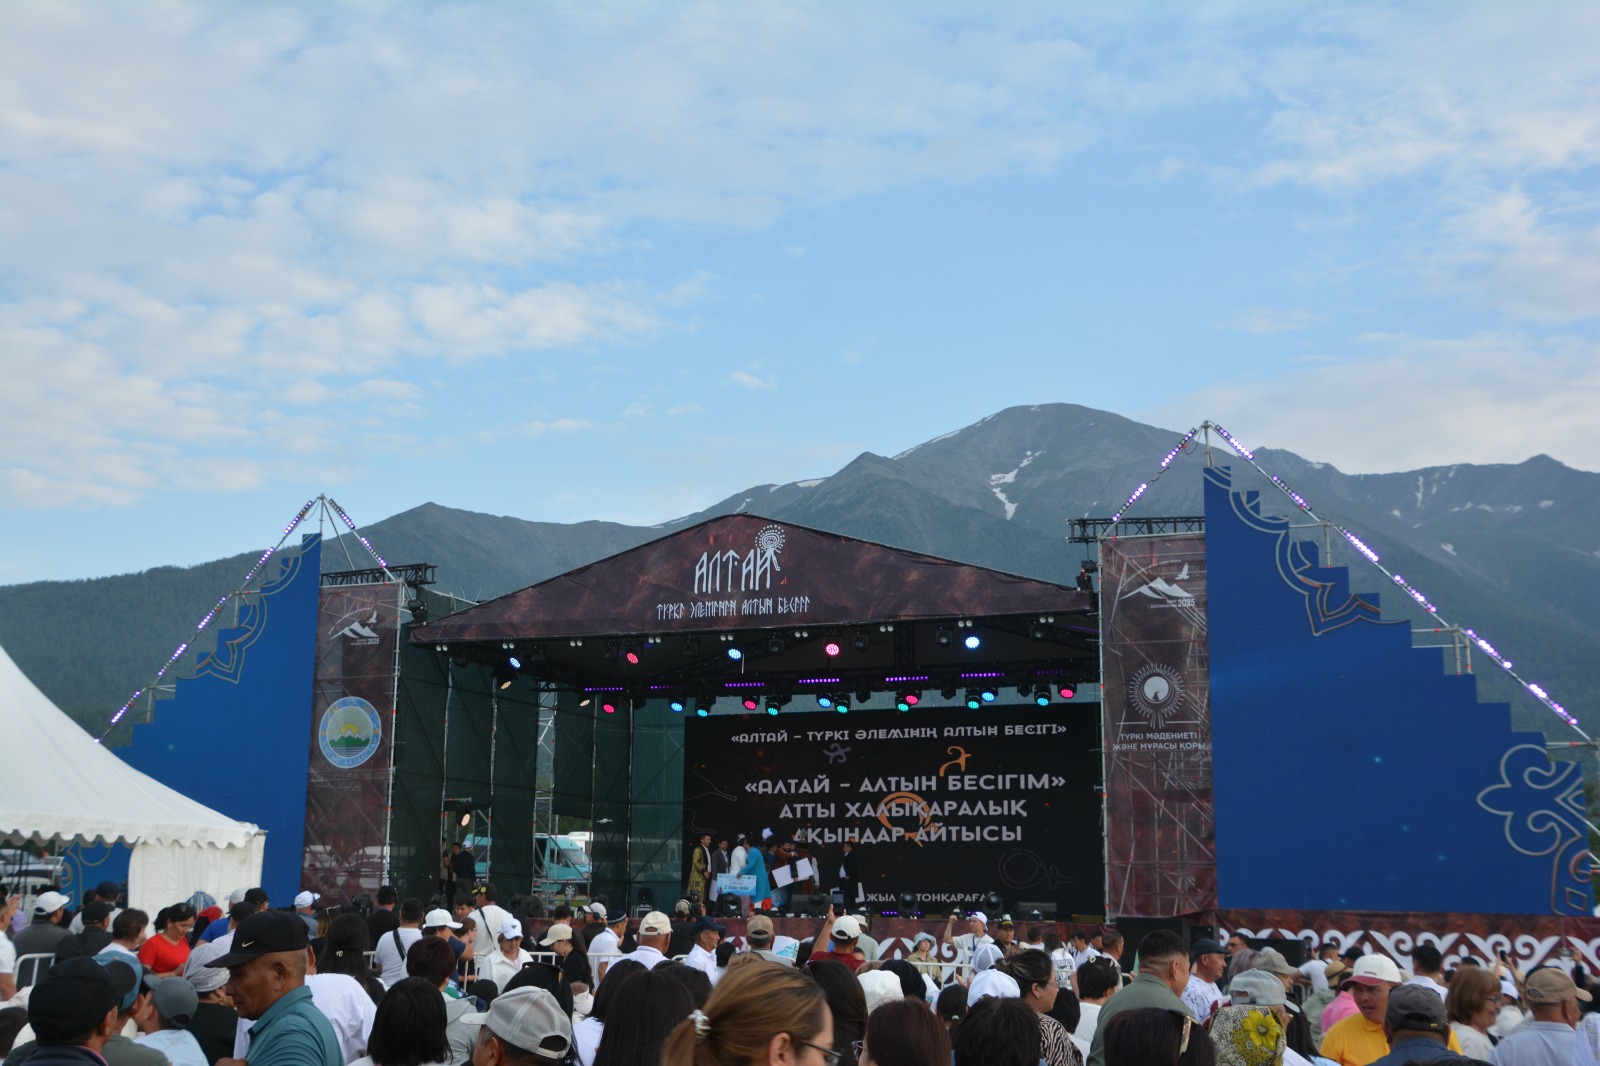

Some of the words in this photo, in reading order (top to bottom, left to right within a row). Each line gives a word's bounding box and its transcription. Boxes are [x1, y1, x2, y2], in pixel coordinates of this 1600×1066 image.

[1177, 598, 1195, 607] 2025
[731, 729, 788, 743] «АЛТАЙ
[806, 731, 850, 742] ТҮРКІ
[855, 728, 938, 741] ӘЛЕМІНІҢ
[943, 726, 998, 738] АЛТЫН
[1004, 723, 1067, 736] БЕСІГІ»
[1146, 732, 1197, 740] МӘДЕНИЕТІ
[1112, 743, 1138, 751] ЖӘНЕ
[1140, 742, 1177, 750] МҰРАСЫ
[1179, 742, 1206, 751] ҚОРЫ
[744, 775, 830, 795] «АЛТАЙ
[859, 774, 937, 793] АЛТЫН
[947, 773, 1066, 791] БЕСІГІМ»
[779, 802, 835, 819] АТТЫ
[845, 799, 1028, 820] ХАЛЫҚАРАЛЫҚ
[914, 821, 1022, 843] АЙТЫСЫ
[866, 892, 896, 902] ЖЫЛ
